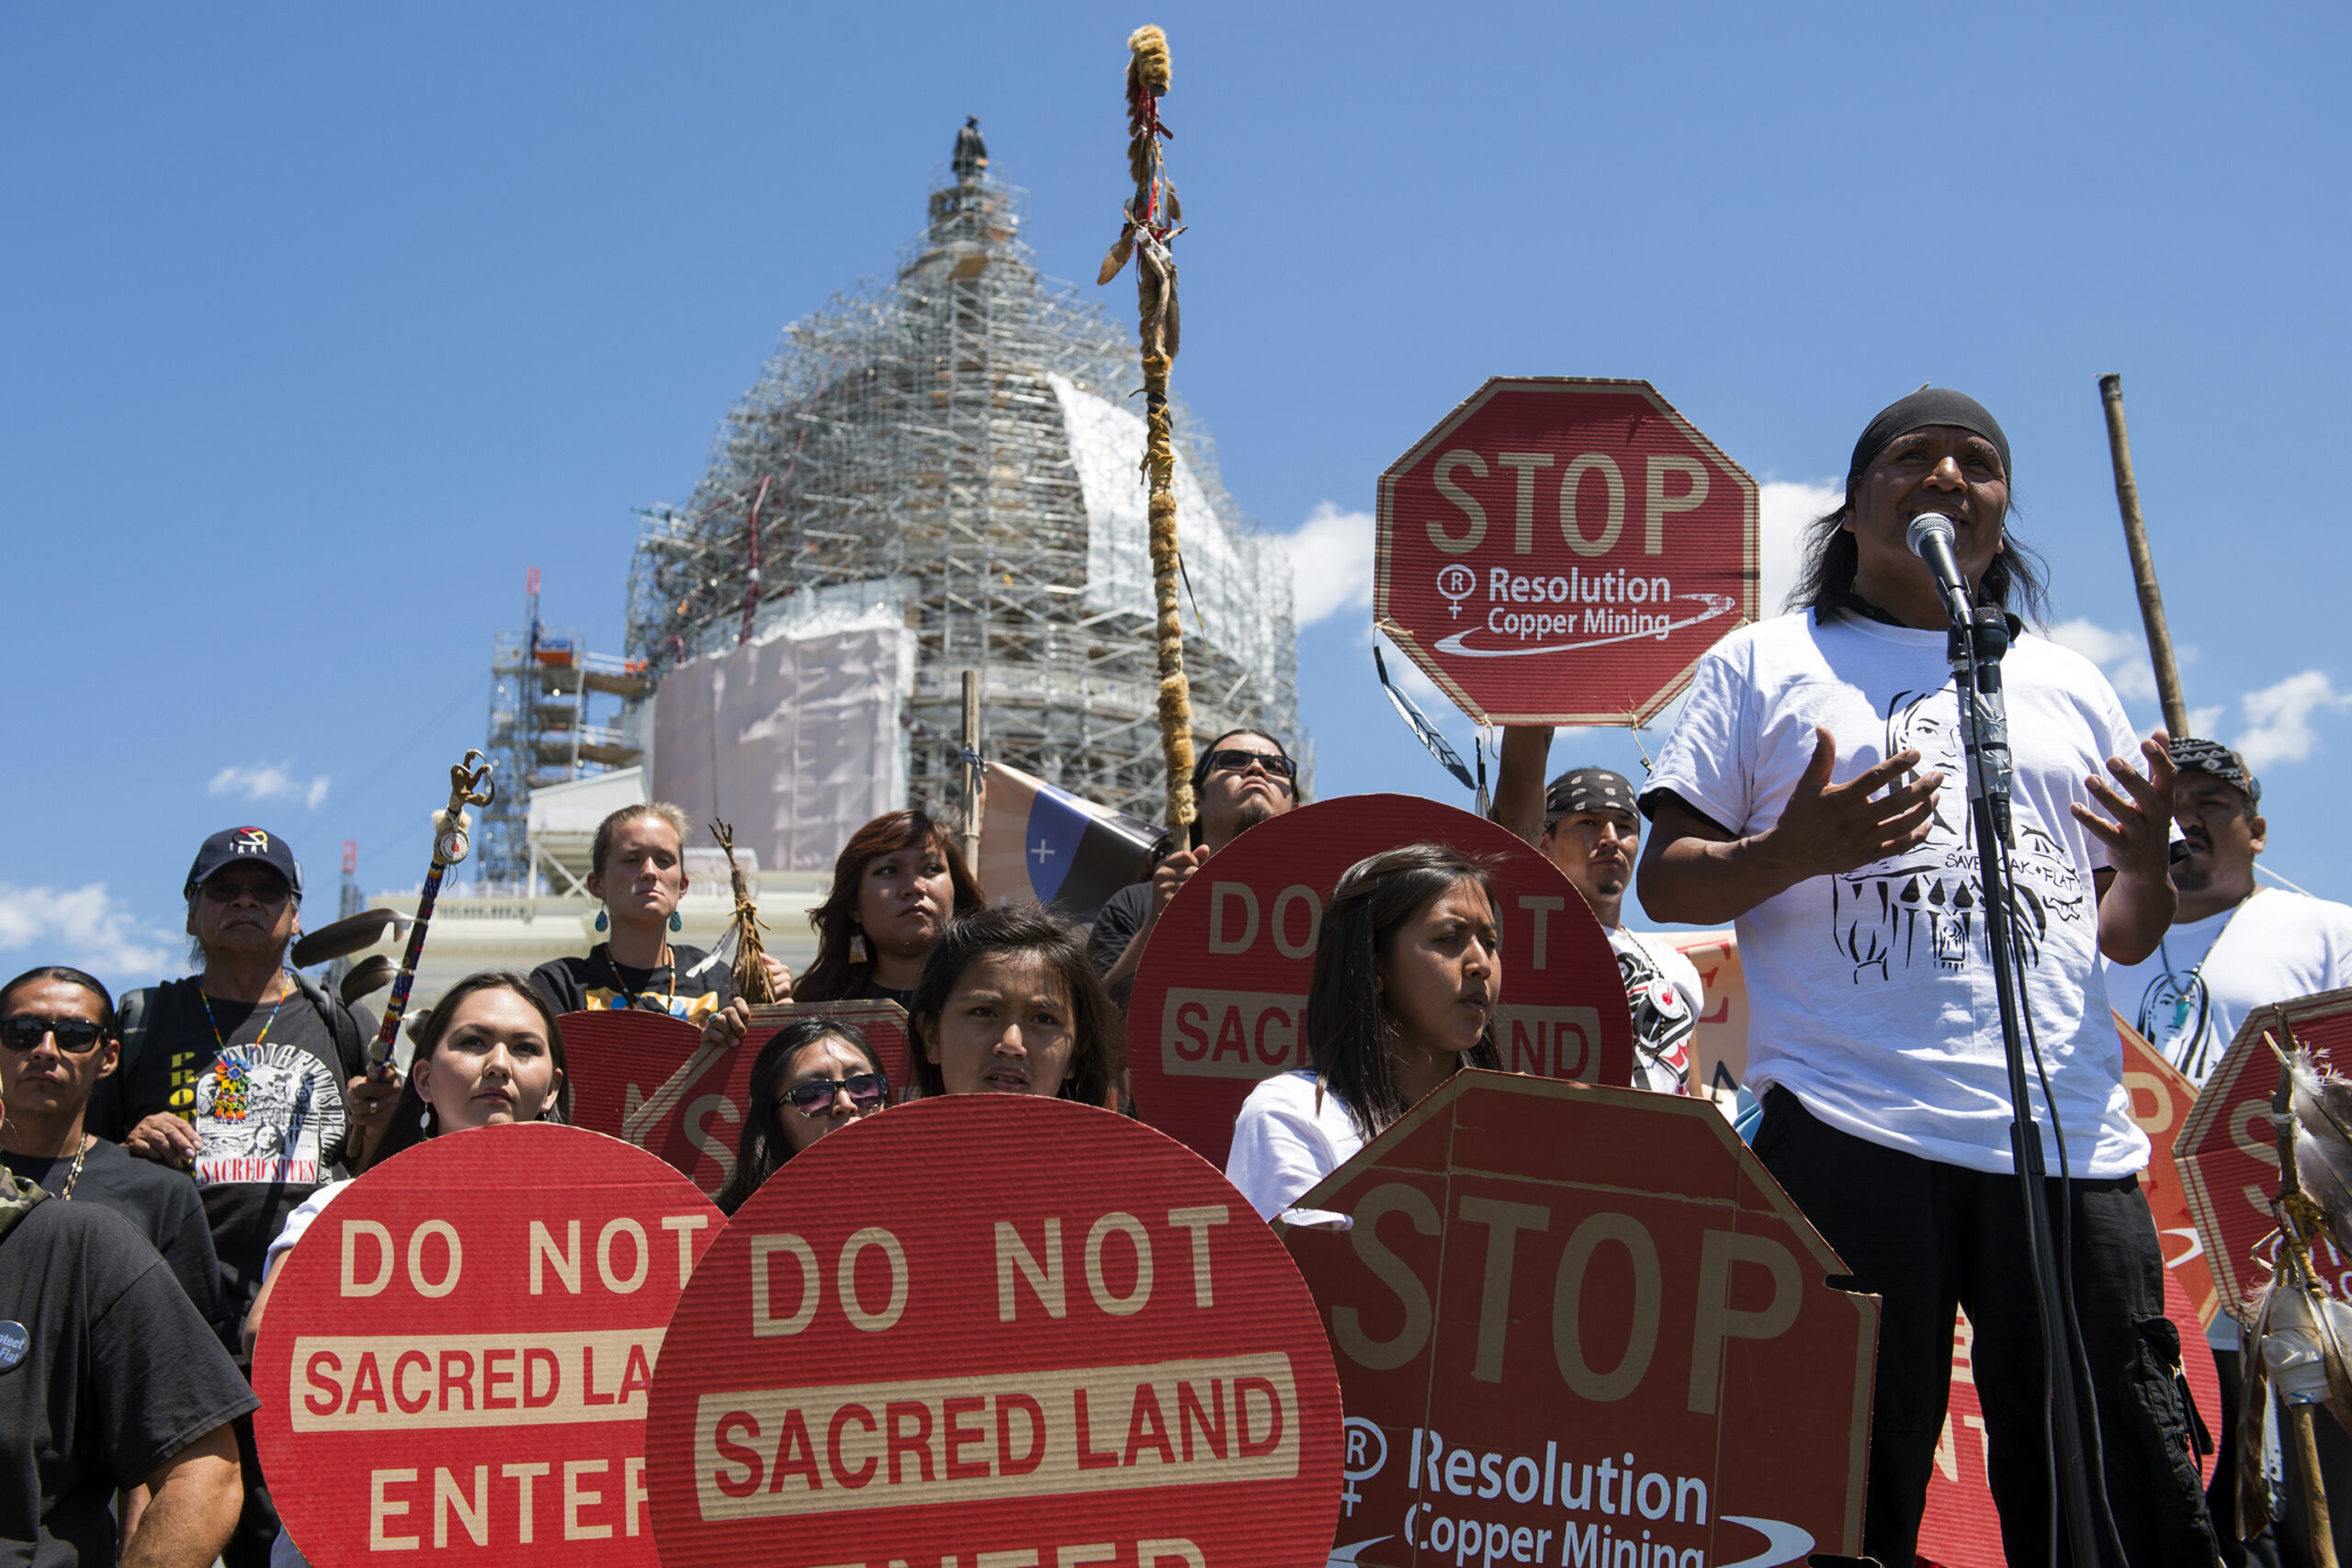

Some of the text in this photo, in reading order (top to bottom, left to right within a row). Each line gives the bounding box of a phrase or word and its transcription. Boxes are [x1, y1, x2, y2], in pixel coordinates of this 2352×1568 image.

[1426, 449, 1710, 558] STOP
[1487, 607, 1670, 640] Copper Mining
[1488, 567, 1671, 603] Resolution
[2042, 867, 2075, 891] FLAT
[1208, 880, 1323, 959] DO
[1174, 1001, 1589, 1083] SAC ND
[200, 1156, 317, 1184] SACRED SITES
[340, 1214, 708, 1299] DO NOT
[750, 1204, 1230, 1338] DO NOT
[1331, 1182, 1804, 1416] STOP
[303, 1344, 652, 1417] SACRED LA
[713, 1375, 1285, 1498] SACRED LAND
[1408, 1427, 1708, 1526] Resolution
[1404, 1501, 1553, 1568] Copper
